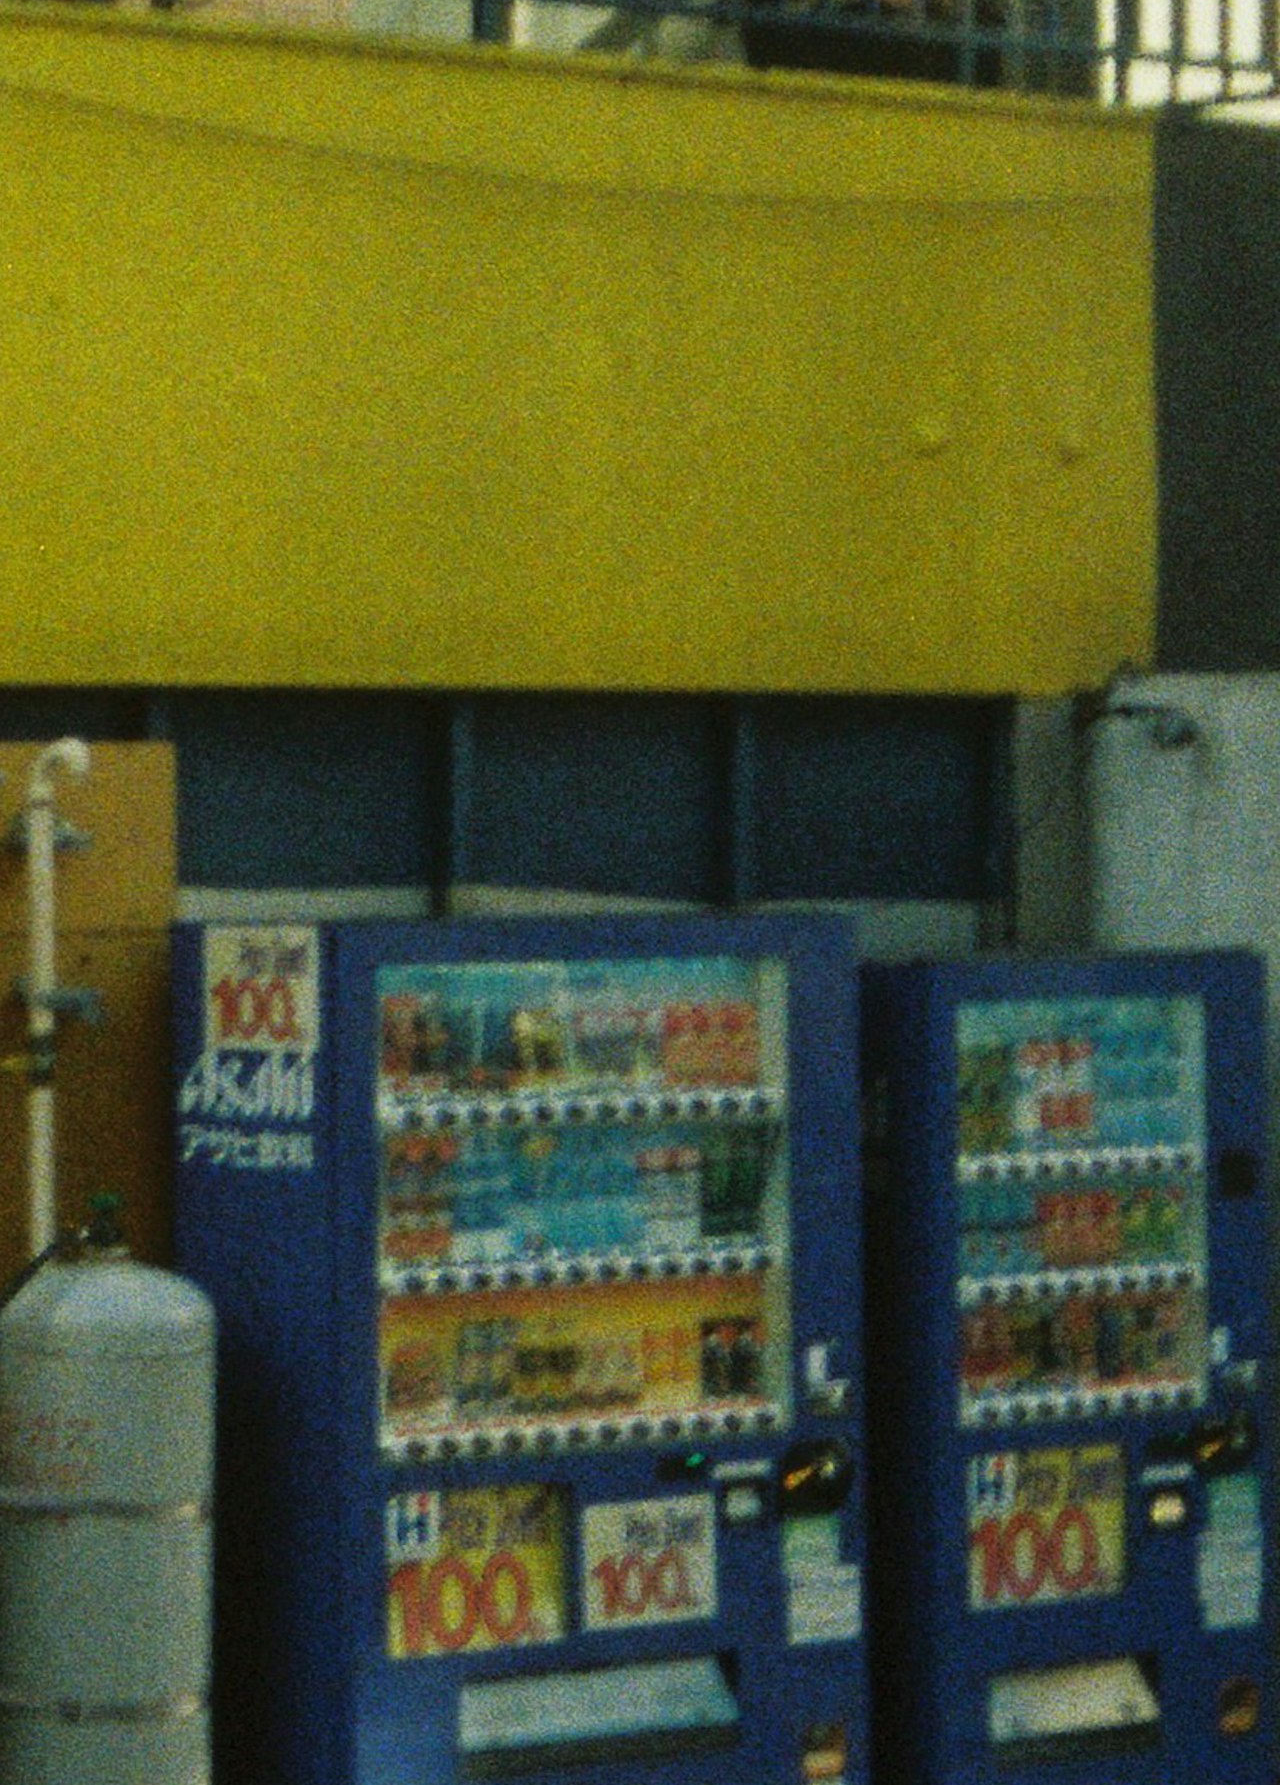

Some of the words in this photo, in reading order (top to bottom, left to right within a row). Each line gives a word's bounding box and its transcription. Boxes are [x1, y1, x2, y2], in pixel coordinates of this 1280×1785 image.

[214, 975, 298, 1043] 100
[593, 1549, 690, 1617] 100
[969, 1505, 1099, 1601] 100
[389, 1550, 531, 1652] 100
